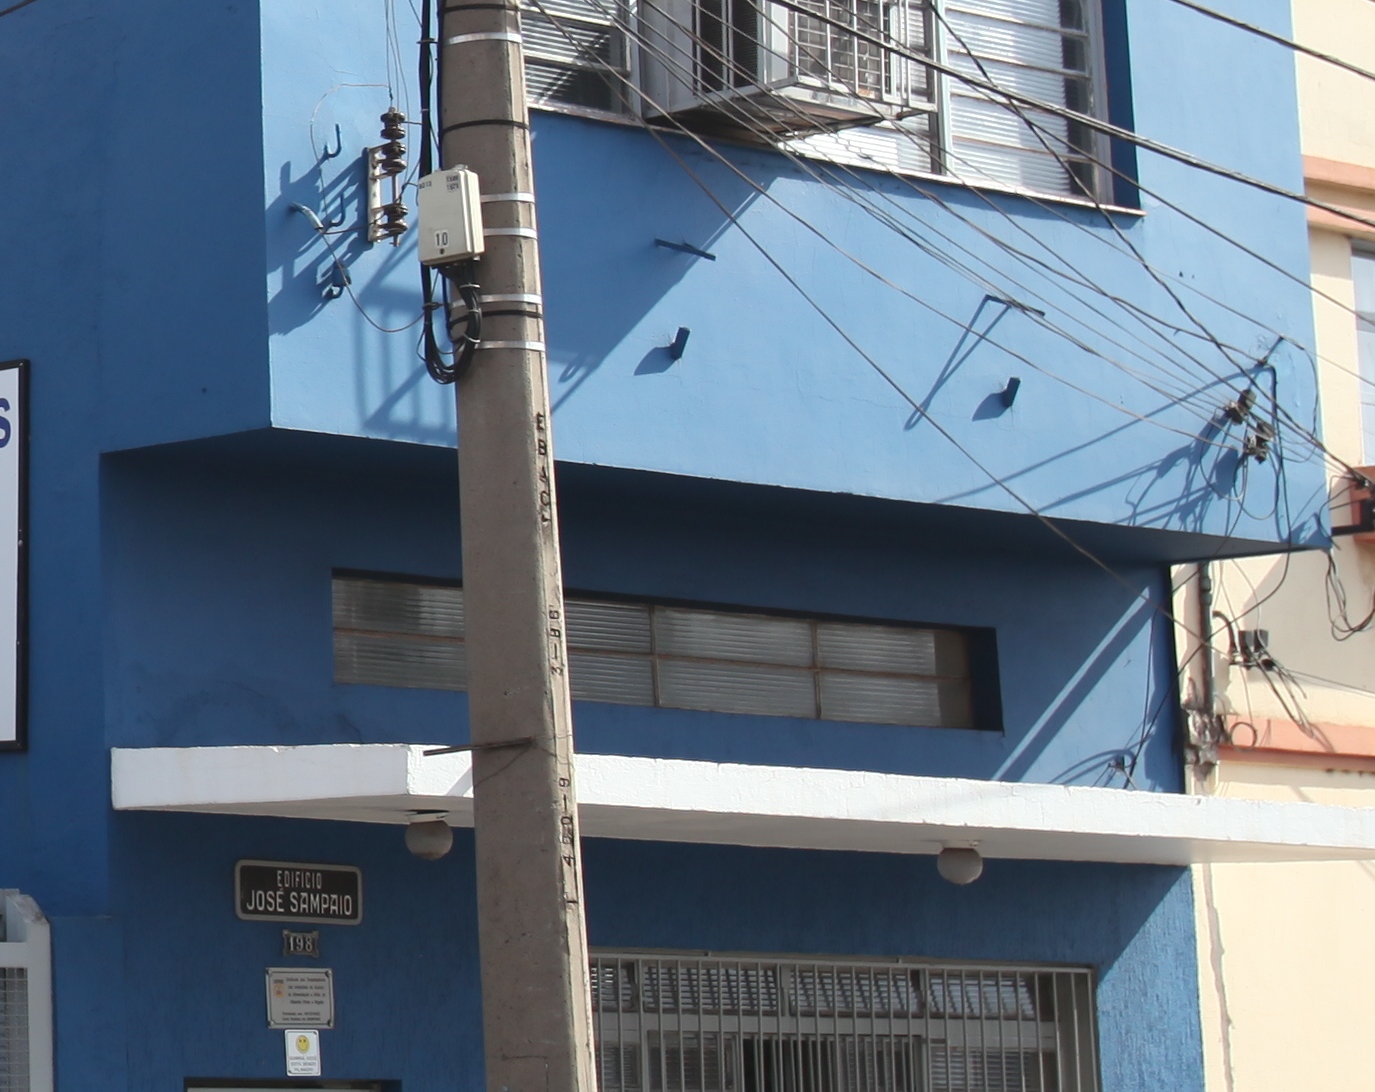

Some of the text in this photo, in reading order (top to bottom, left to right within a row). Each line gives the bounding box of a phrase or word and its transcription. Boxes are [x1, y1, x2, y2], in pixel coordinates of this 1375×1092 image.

[436, 232, 448, 246] 10
[290, 891, 352, 915] SAMPAIO
[289, 936, 313, 952] 198
